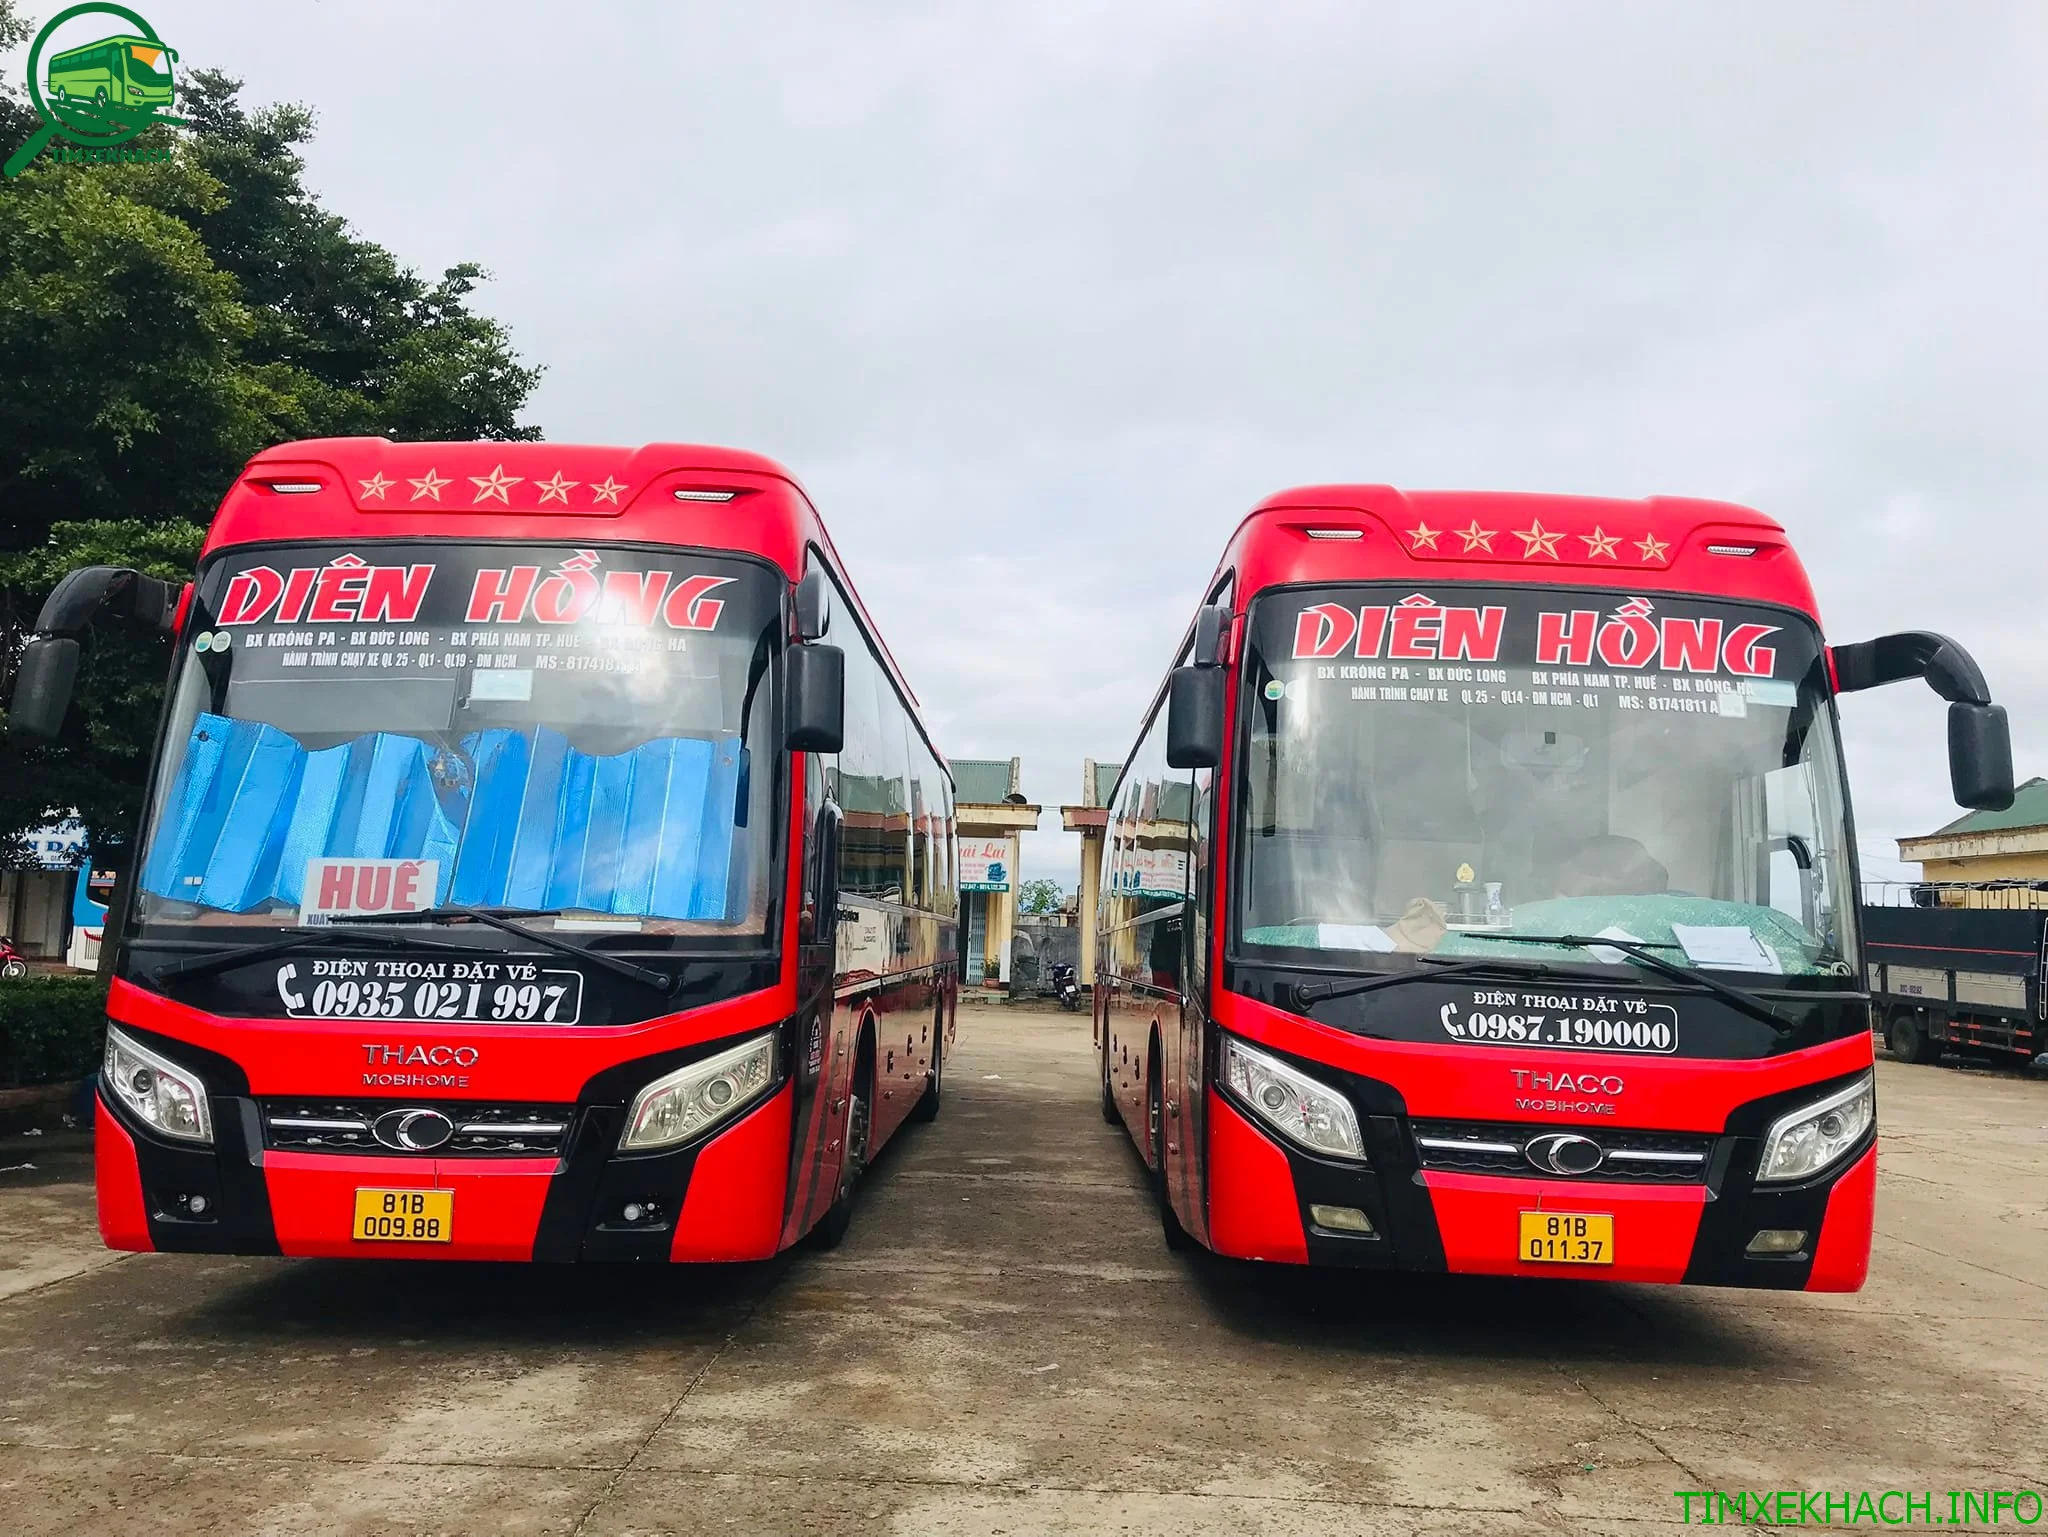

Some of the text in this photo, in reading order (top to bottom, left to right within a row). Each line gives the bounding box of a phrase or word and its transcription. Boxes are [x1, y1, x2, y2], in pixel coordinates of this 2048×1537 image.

[215, 549, 739, 631] DIÊN HỒNG
[245, 633, 264, 648] BX
[318, 631, 336, 646] PA
[350, 631, 367, 646] BX
[399, 631, 430, 646] LONG
[451, 631, 467, 646] BX
[504, 633, 531, 647] NAM
[1291, 592, 1784, 678] DIÊN HỒNG
[367, 653, 379, 667] XE
[381, 653, 393, 668] QL
[395, 653, 408, 667] 25
[418, 653, 435, 668] QL1
[444, 654, 466, 668] QL19
[494, 654, 517, 669] HCM
[1317, 666, 1336, 680] BX
[1391, 666, 1409, 681] PA
[1428, 667, 1444, 682] BX
[1477, 669, 1507, 684] LONG
[1532, 671, 1549, 685] BX
[1583, 673, 1610, 688] NAM
[1672, 678, 1691, 692] BX
[1438, 688, 1449, 702] XE
[1461, 689, 1473, 705] QL
[1475, 690, 1488, 704] 25
[1501, 690, 1524, 705] QL14
[1550, 692, 1572, 707] HCM
[1583, 693, 1599, 709] QL1
[318, 860, 424, 911] HUẾ
[312, 959, 537, 984] ĐIỆN THOẠI ĐẶT VÉ
[312, 980, 568, 1022] 0935 021 997
[1473, 990, 1517, 1008] ĐIỆN
[1522, 994, 1578, 1011] THOẠI
[1583, 996, 1619, 1014] ĐẶT
[1468, 1012, 1671, 1049] 0987.190000
[362, 1043, 479, 1067] THACO
[362, 1073, 470, 1088] MOBIHOME
[1510, 1068, 1624, 1095] THACO
[1515, 1098, 1616, 1115] MOBIHOME
[383, 1193, 425, 1214] 81B
[364, 1216, 440, 1238] 009.88
[1547, 1217, 1587, 1237] 81B
[1530, 1238, 1603, 1260] 011.37
